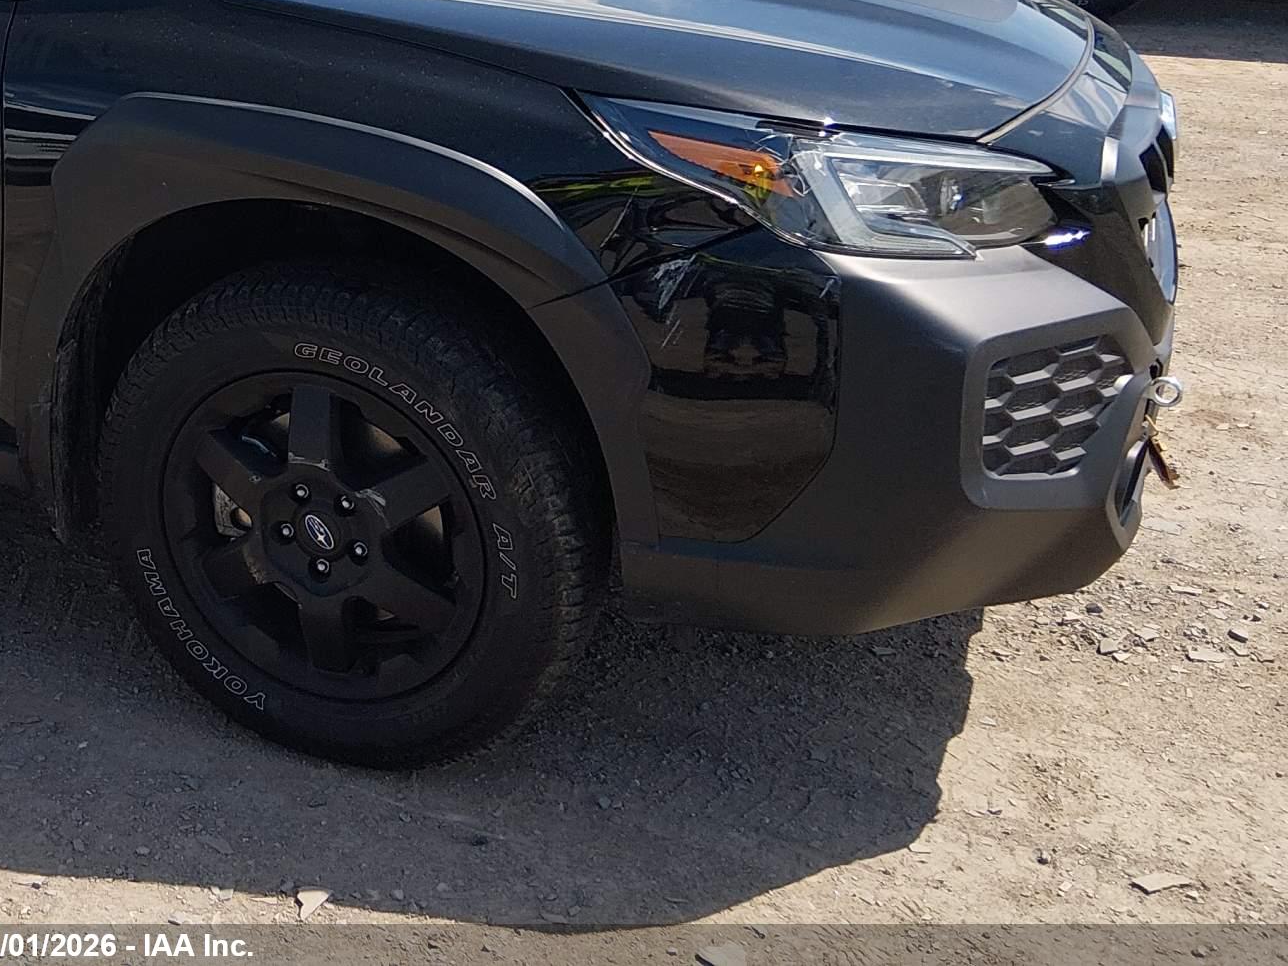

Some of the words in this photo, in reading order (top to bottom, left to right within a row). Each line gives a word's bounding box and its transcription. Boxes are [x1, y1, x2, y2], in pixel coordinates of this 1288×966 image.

[293, 342, 497, 502] GEOLANDAR
[492, 521, 521, 600] A/T
[136, 548, 266, 712] YOKOHAMA
